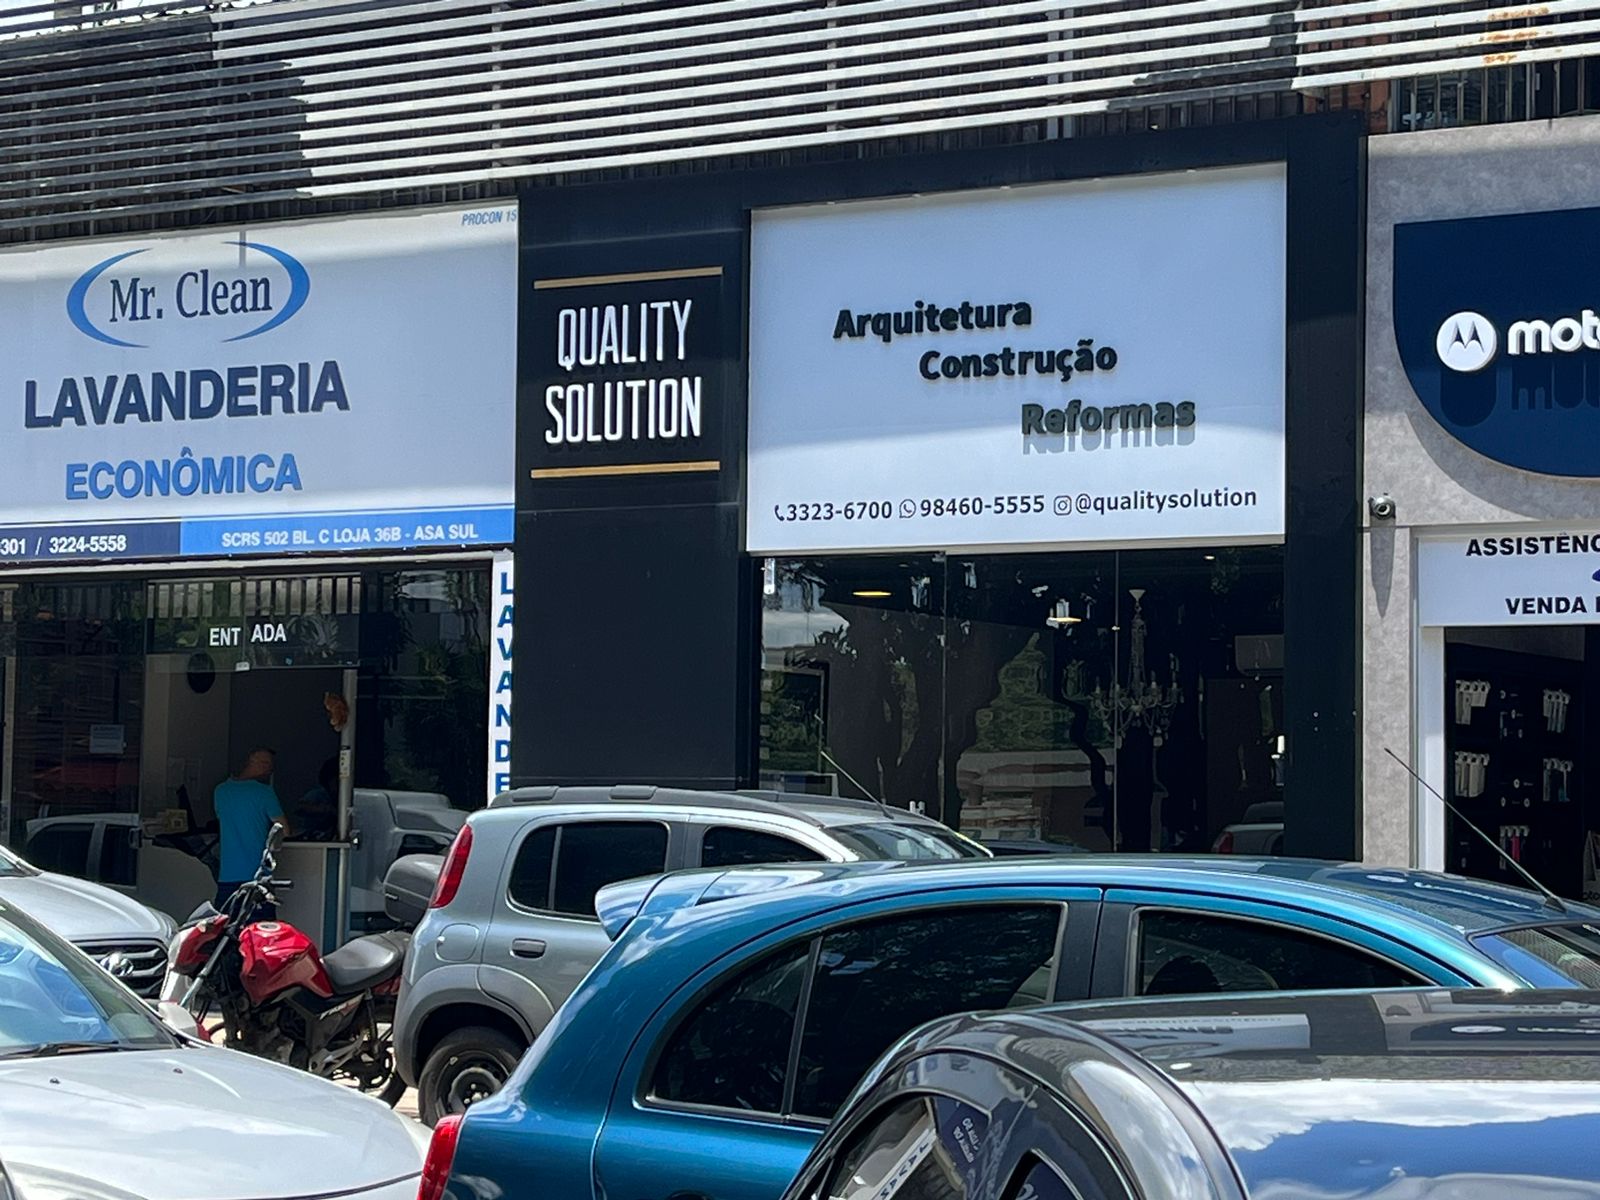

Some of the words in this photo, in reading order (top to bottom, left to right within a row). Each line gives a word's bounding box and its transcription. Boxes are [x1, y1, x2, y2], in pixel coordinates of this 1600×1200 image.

[461, 211, 503, 226] PROCON
[109, 277, 163, 322] Mr.
[176, 269, 273, 318] Clean
[558, 299, 692, 371] QUALITY
[833, 300, 1032, 343] Arquitetura
[1507, 309, 1600, 355] mot
[919, 338, 1118, 382] Construção
[25, 360, 350, 428] LAVANDERIA
[545, 376, 702, 443] SOLUTION
[1021, 399, 1196, 435] Reformas
[65, 446, 302, 500] ECONÔMICA
[786, 501, 893, 521] 3323-6700
[920, 495, 1045, 517] 98460-5555
[1075, 487, 1257, 515] @qualitysolution
[49, 535, 127, 553] 3224-5558
[222, 532, 260, 547] SCRS
[264, 530, 289, 545] 502
[319, 528, 330, 544] C
[333, 527, 371, 543] LOJA
[374, 526, 402, 542] 36B
[413, 525, 445, 541] ASA
[448, 523, 479, 540] SUL
[1505, 596, 1588, 615] VENDA
